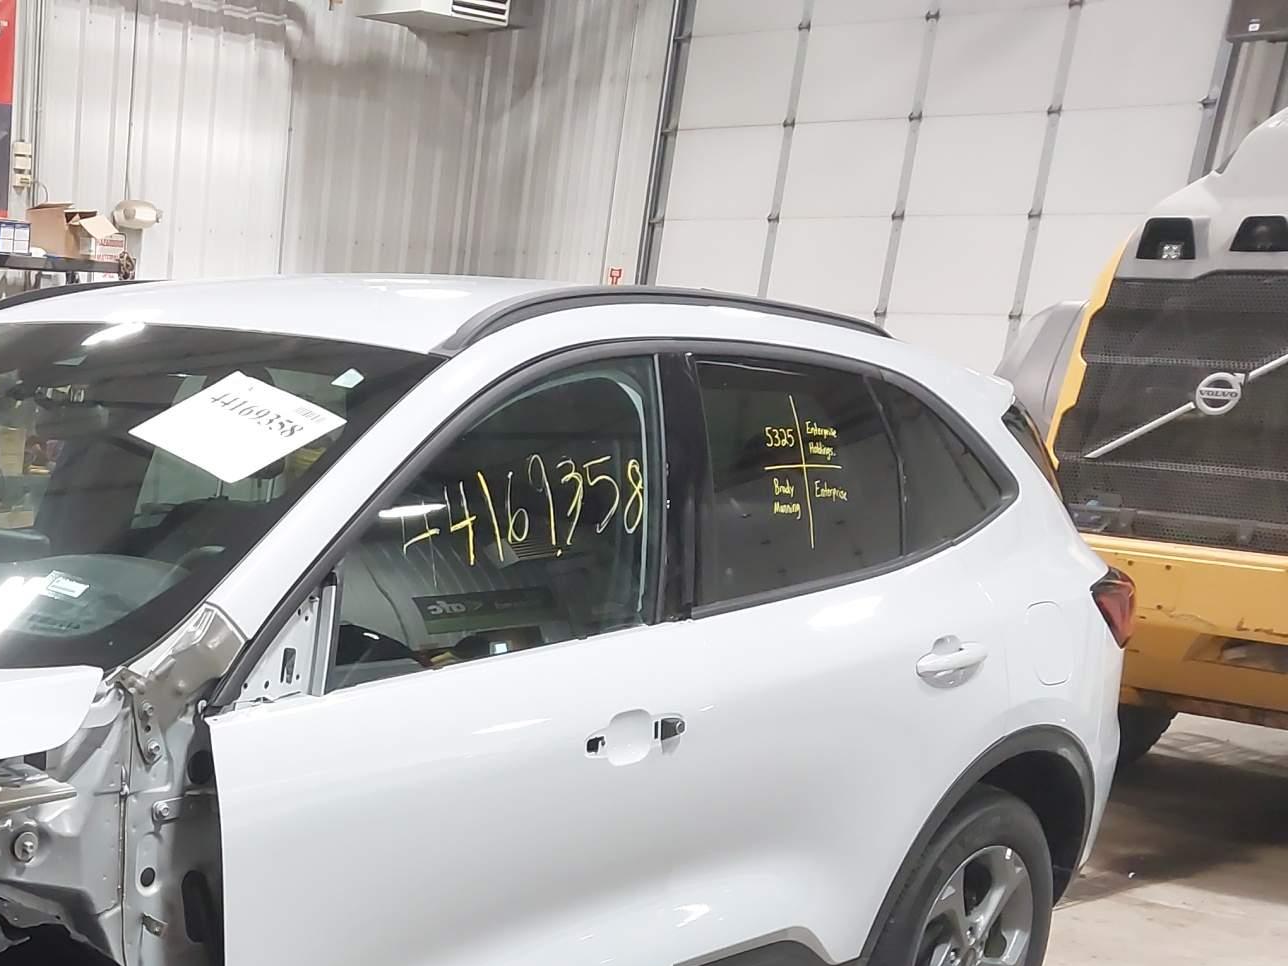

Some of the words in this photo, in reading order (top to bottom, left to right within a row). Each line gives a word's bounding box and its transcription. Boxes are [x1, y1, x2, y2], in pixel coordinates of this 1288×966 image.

[1199, 389, 1238, 398] VOLVO
[765, 426, 795, 448] 5325
[814, 480, 848, 501] Enterprise
